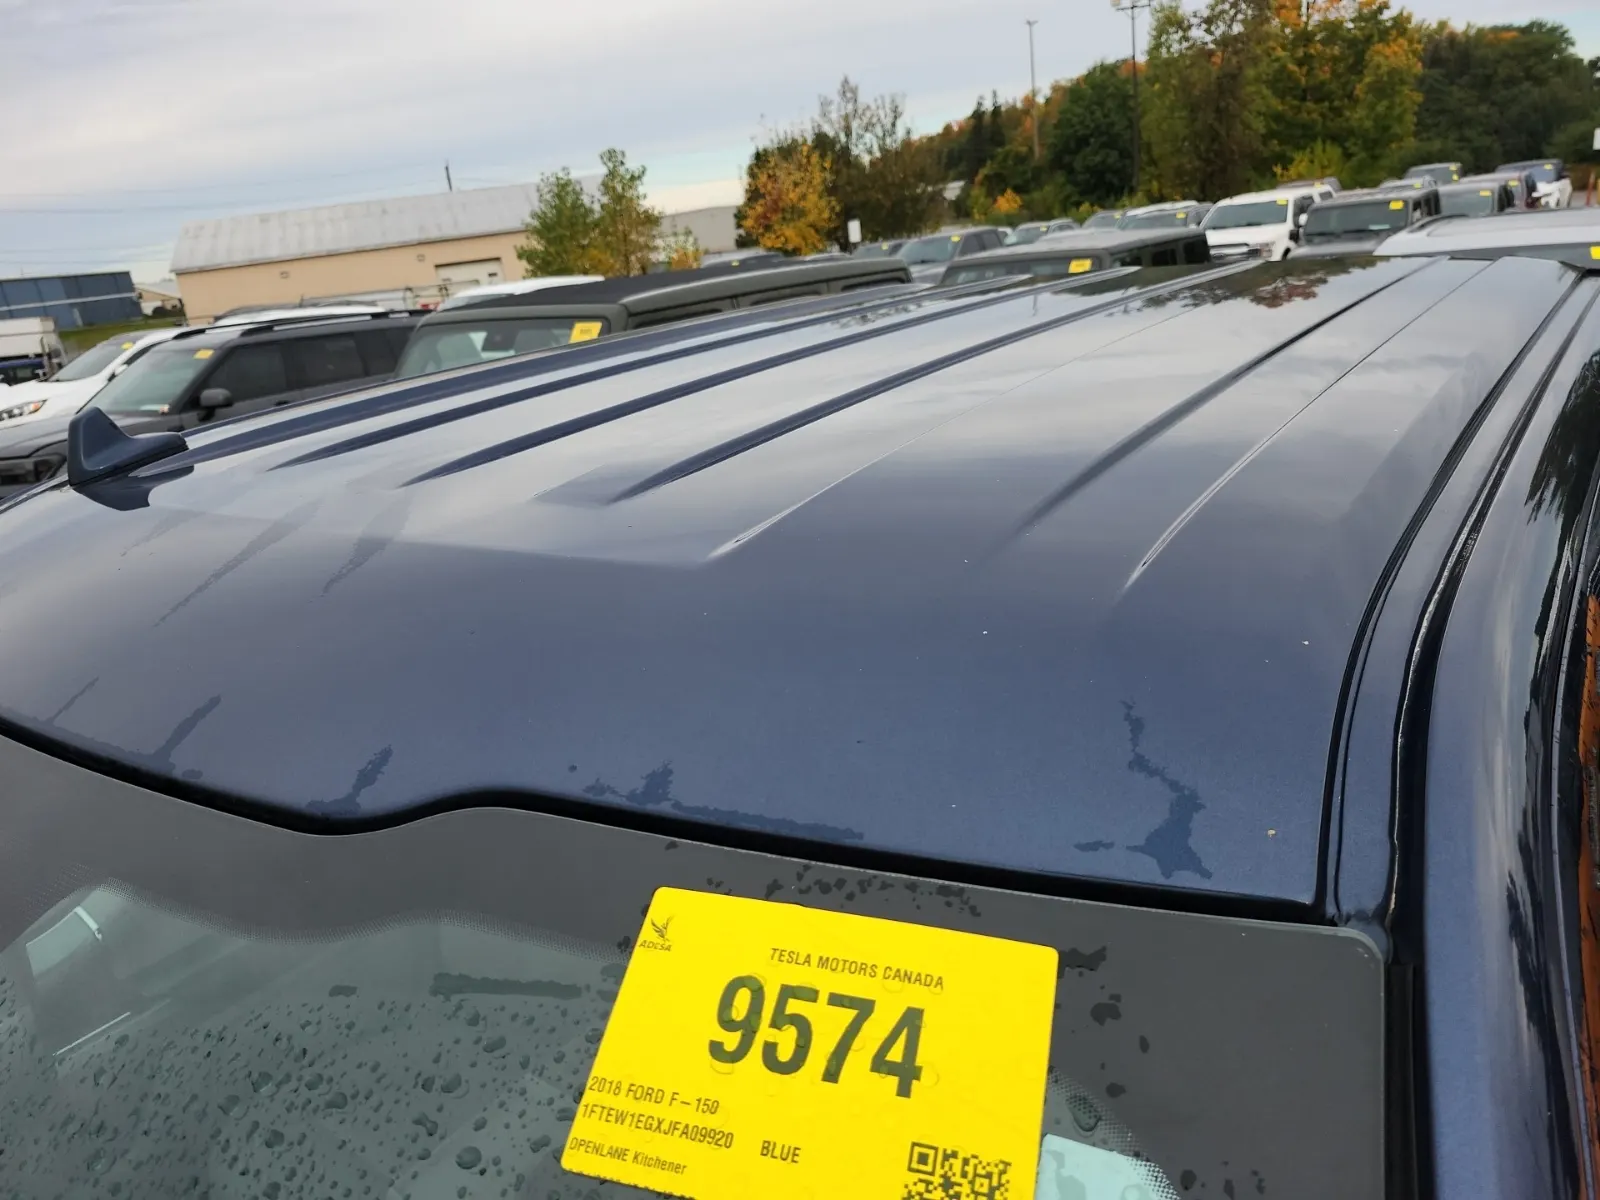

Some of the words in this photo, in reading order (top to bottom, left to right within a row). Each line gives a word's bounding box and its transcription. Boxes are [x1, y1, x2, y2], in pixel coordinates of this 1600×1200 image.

[638, 939, 673, 952] ADESA
[770, 948, 812, 967] TESLA
[817, 955, 878, 978] MOTORS
[883, 966, 944, 989] CANADA
[708, 974, 925, 1099] 9574
[588, 1075, 622, 1096] 2018
[625, 1083, 665, 1104] FORD
[581, 1103, 734, 1149] 1FTEW1EGXJFA09920
[760, 1140, 802, 1164] BLUE
[569, 1137, 630, 1162] OPENLANE
[632, 1151, 688, 1175] Kitchener
